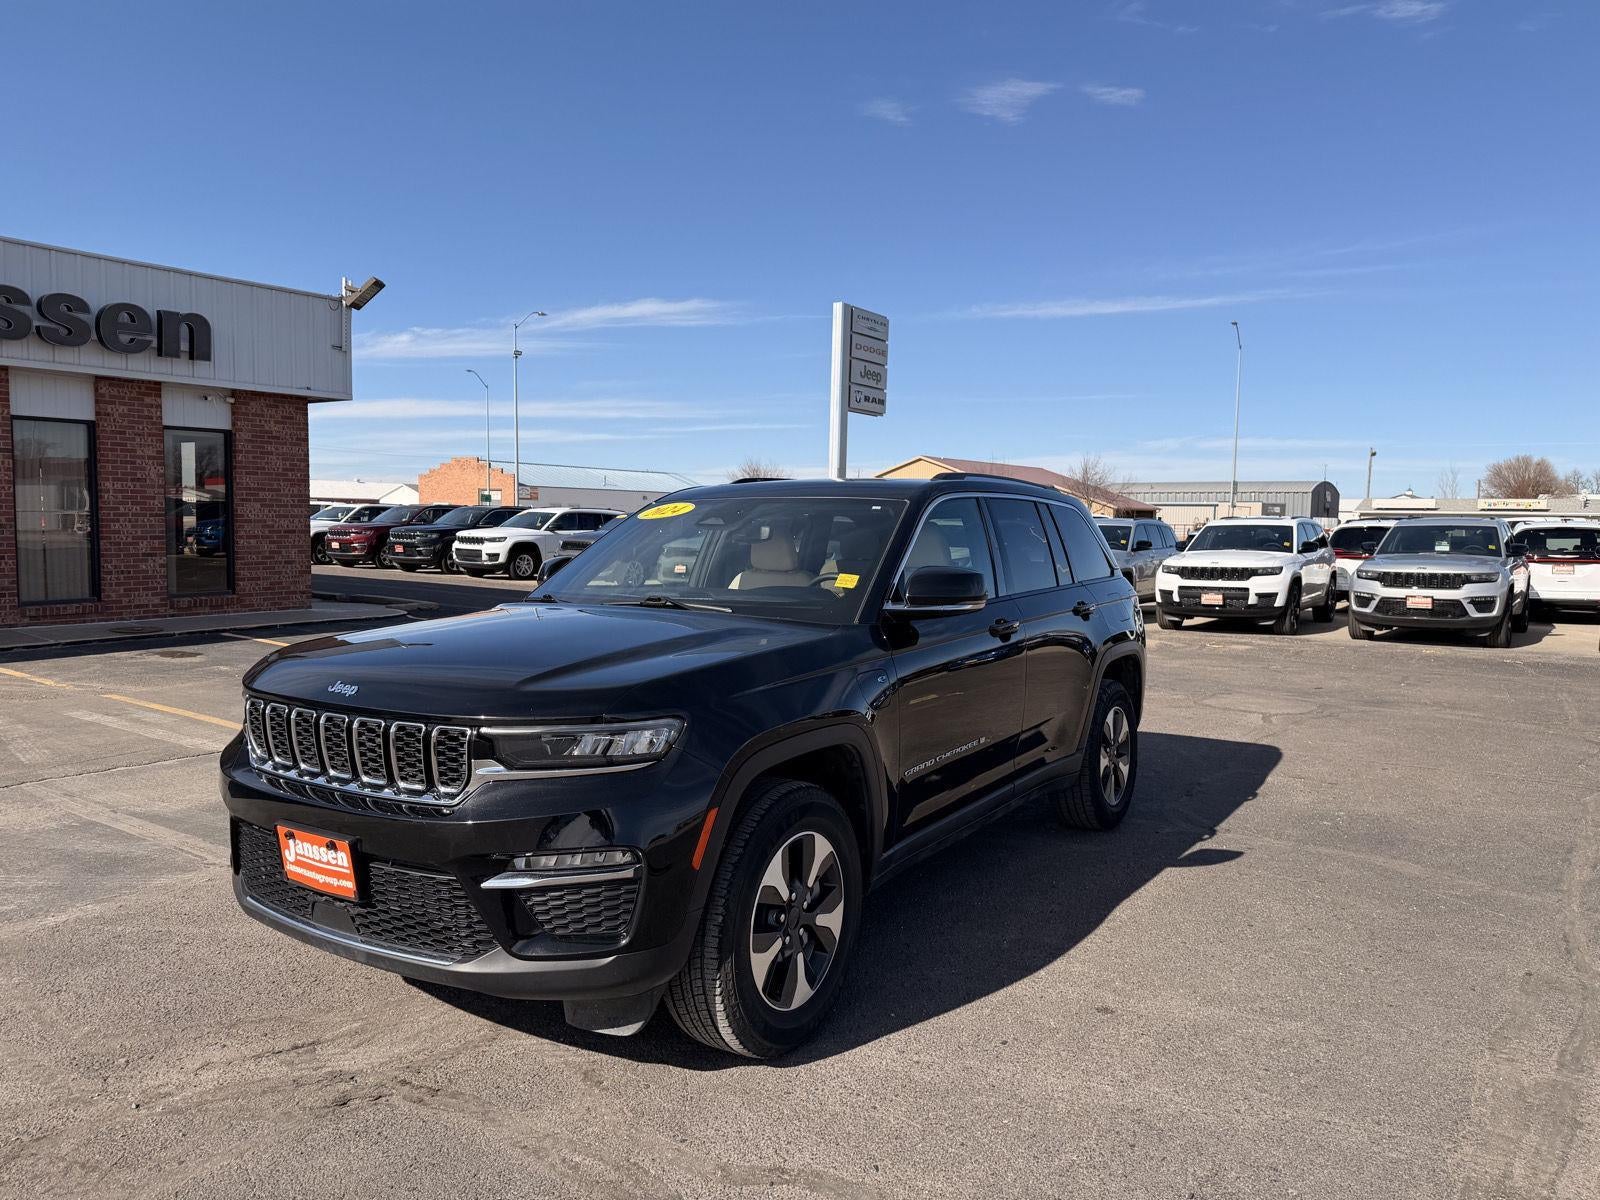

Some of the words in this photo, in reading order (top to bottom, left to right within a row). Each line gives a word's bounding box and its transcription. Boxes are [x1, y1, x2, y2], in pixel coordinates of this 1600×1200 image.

[855, 343, 887, 357] DODGE
[860, 365, 882, 384] Jeep
[864, 395, 885, 406] RAM
[328, 680, 359, 697] Jeep
[904, 759, 935, 776] GRAND
[284, 838, 349, 867] Janssen
